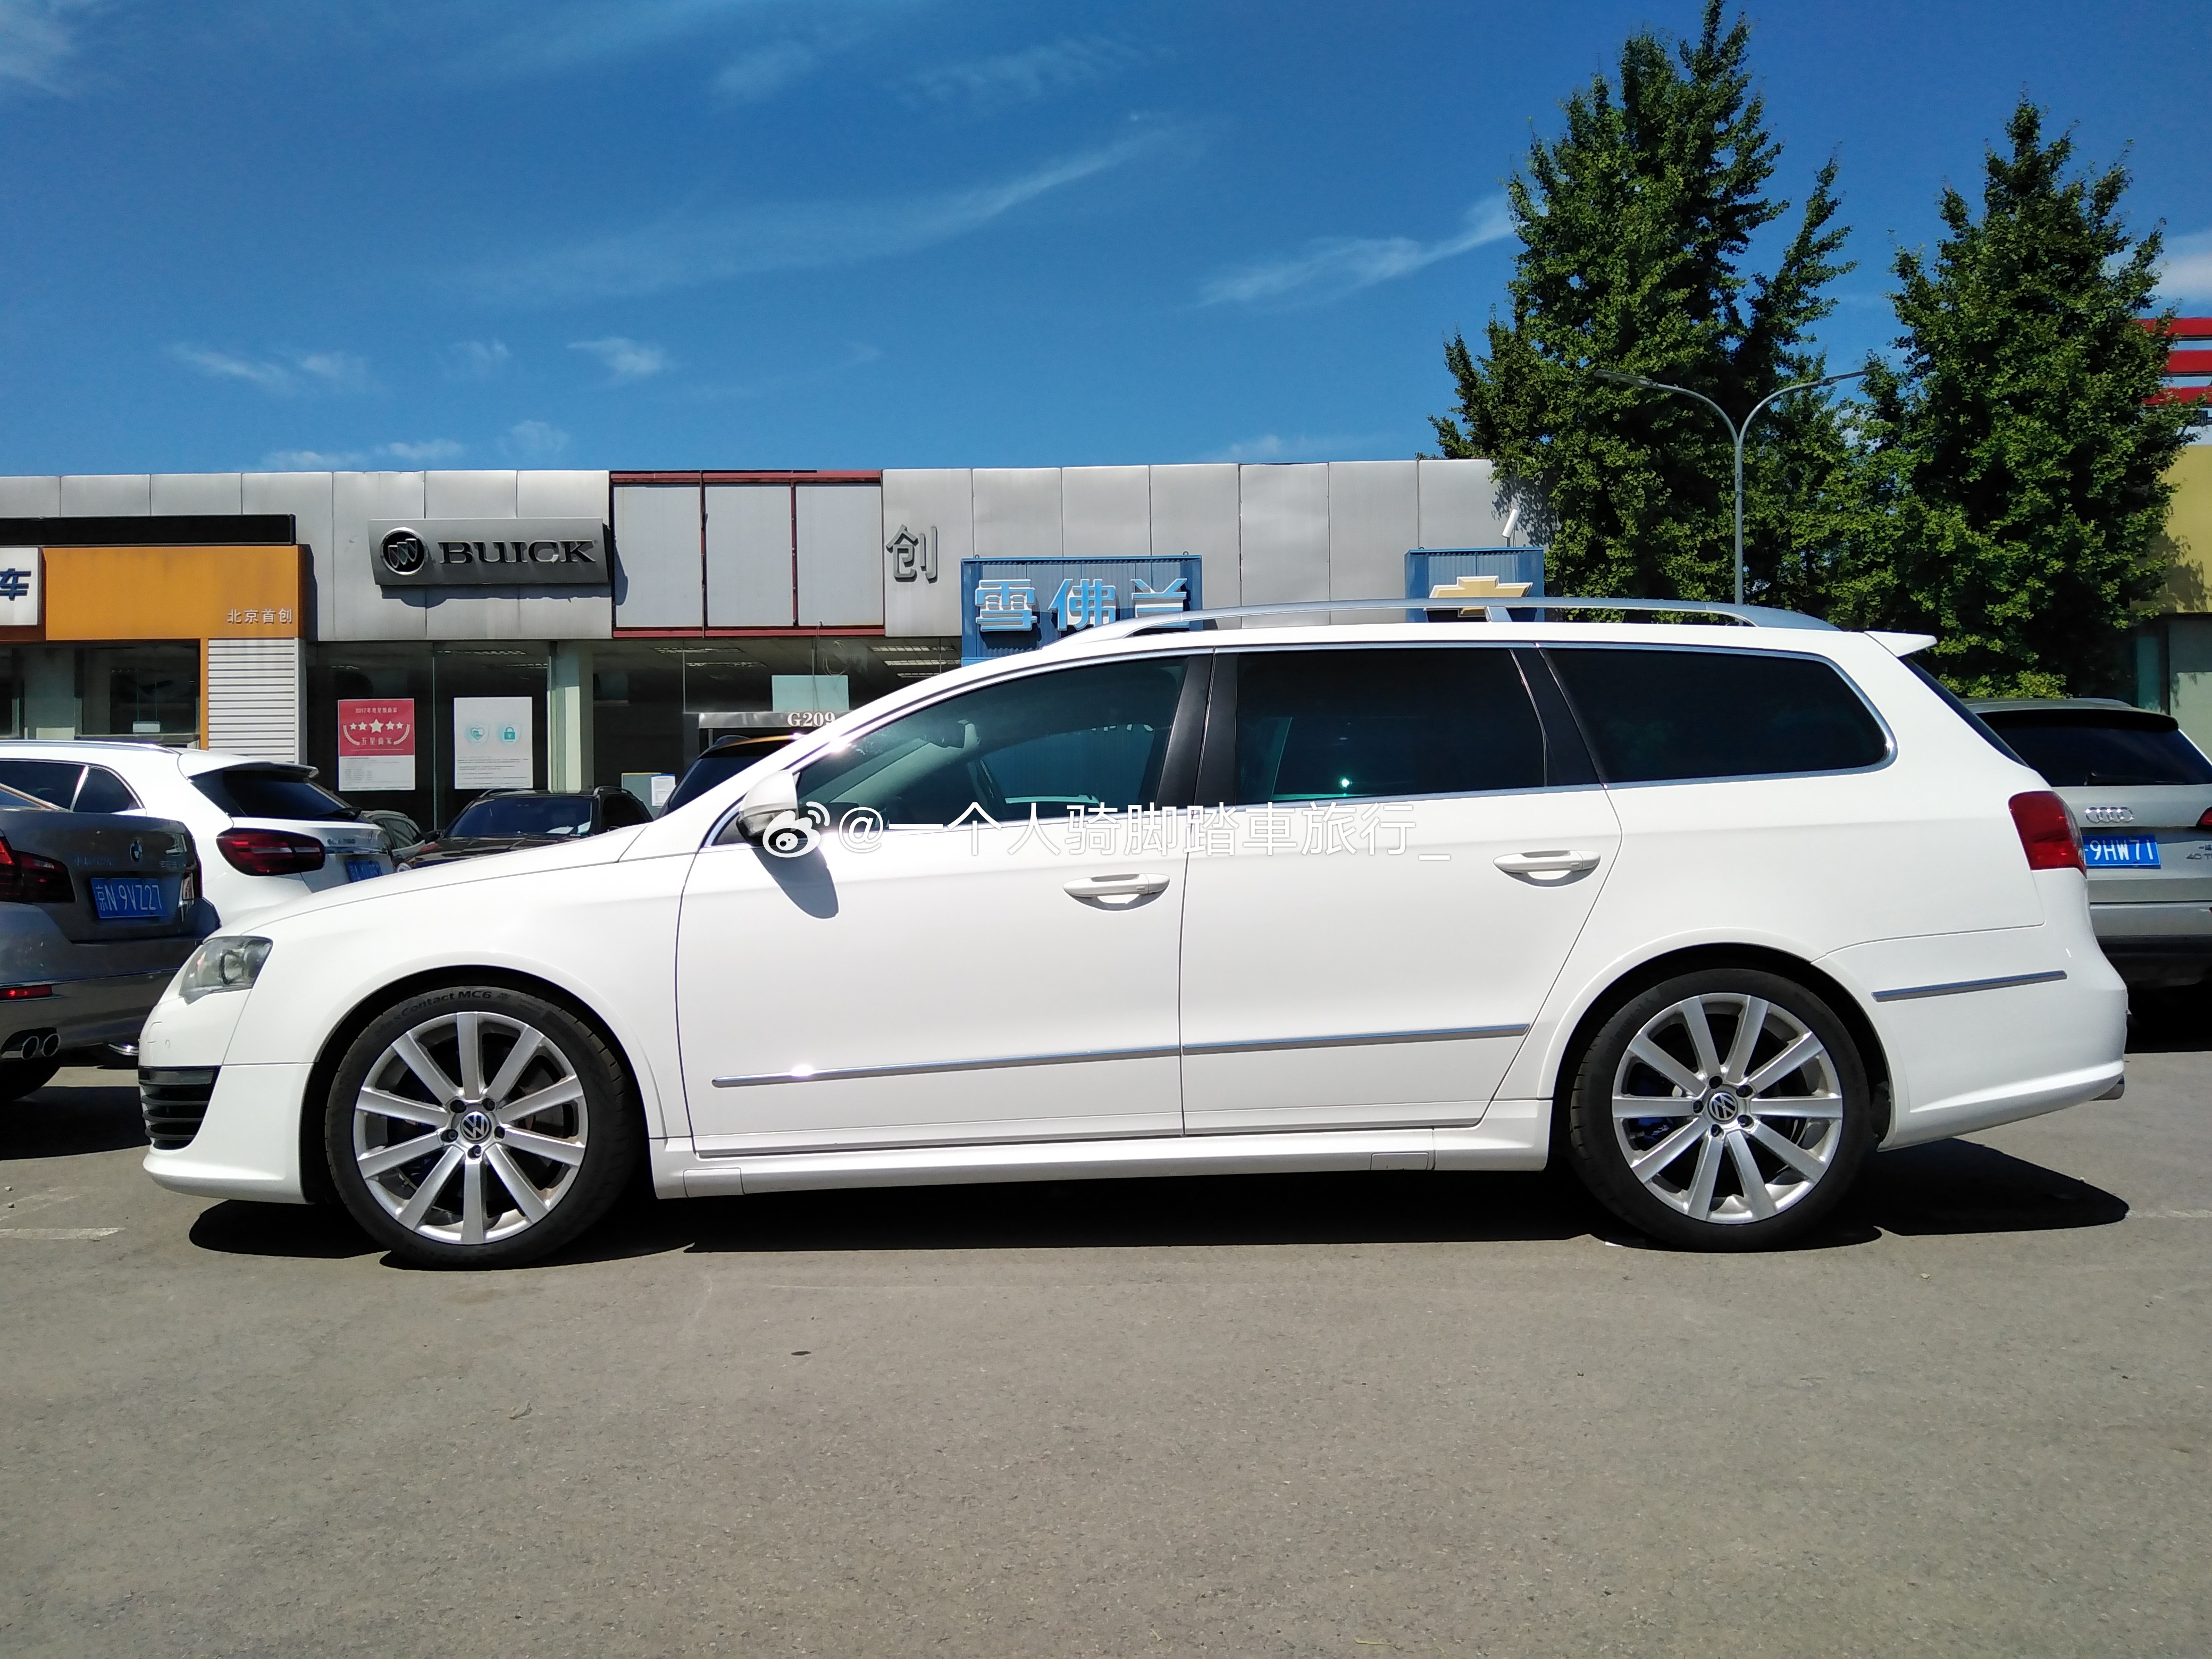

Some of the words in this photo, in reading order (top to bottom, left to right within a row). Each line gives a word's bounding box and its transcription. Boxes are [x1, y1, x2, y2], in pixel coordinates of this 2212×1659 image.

[437, 540, 596, 564] BUICK
[885, 524, 938, 584] 创
[0, 568, 31, 601] 车
[227, 608, 292, 624] 北京首创
[975, 578, 1190, 631] 雪佛兰
[787, 712, 835, 727] G209
[458, 990, 492, 999] MC6
